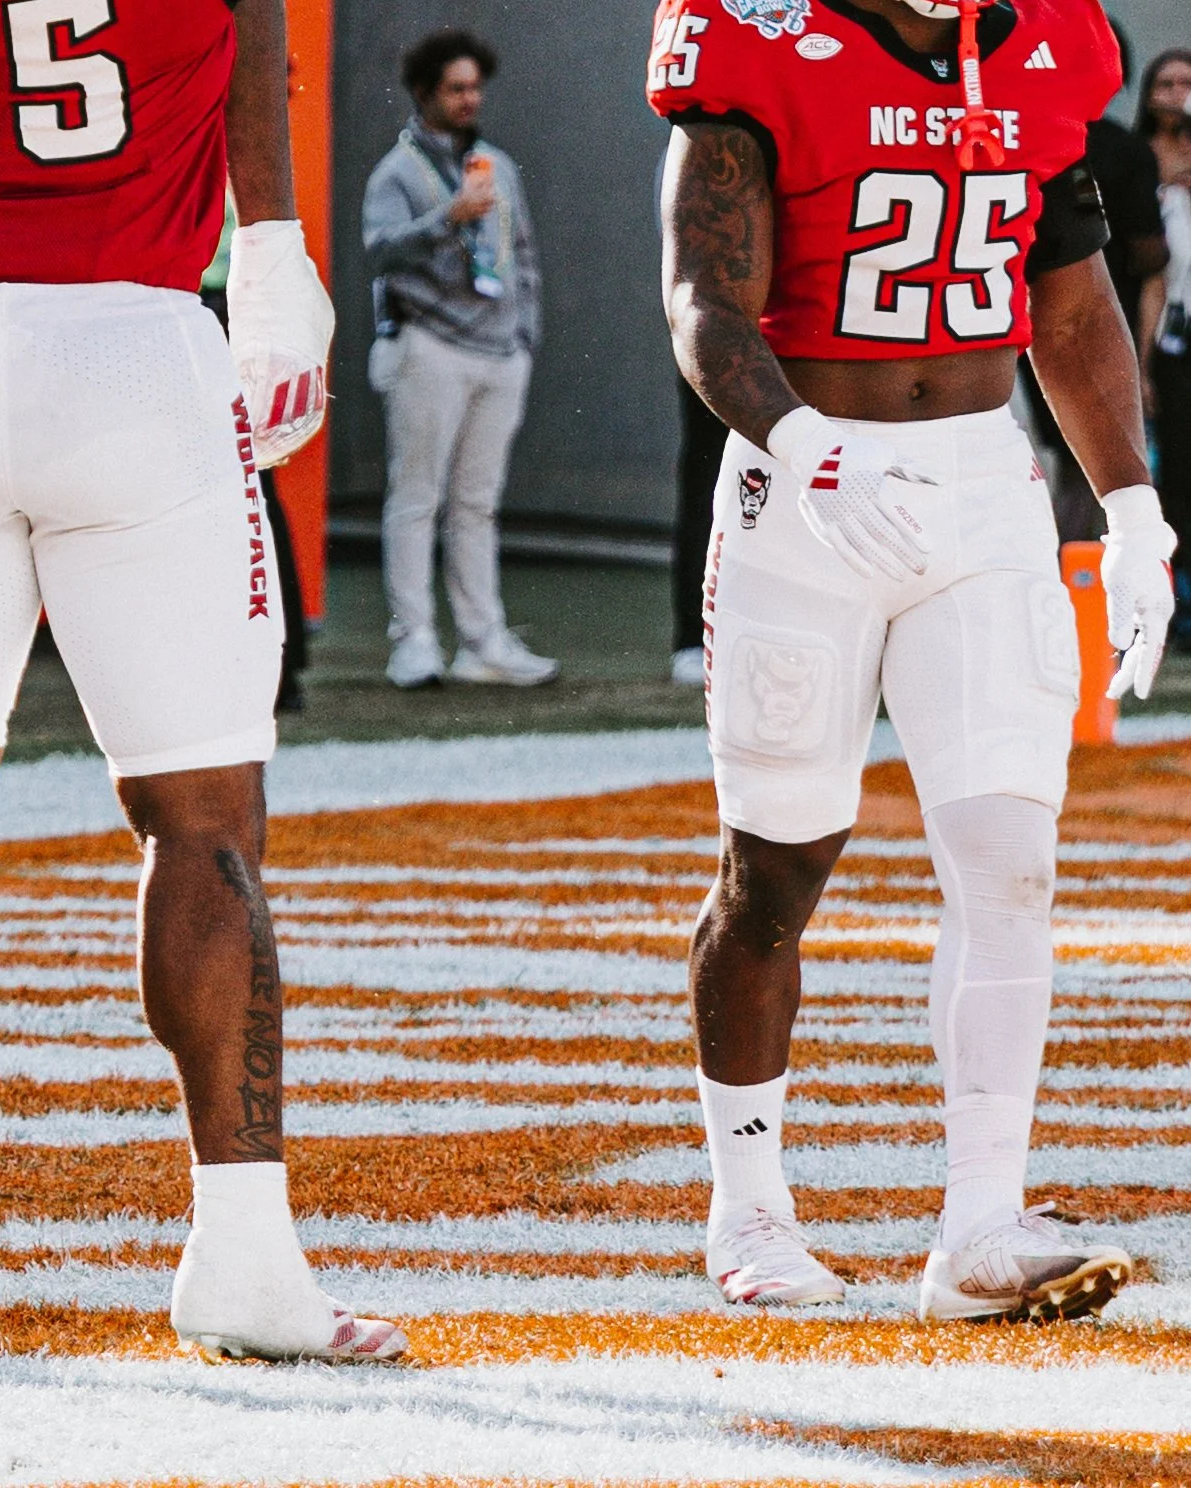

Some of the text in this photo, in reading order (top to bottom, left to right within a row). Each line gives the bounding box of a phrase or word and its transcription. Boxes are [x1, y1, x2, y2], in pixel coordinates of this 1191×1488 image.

[648, 14, 710, 92] 25
[804, 40, 833, 50] ACC
[869, 106, 1020, 150] NC STE
[834, 168, 1032, 344] 25
[230, 392, 270, 621] WOLFPACK
